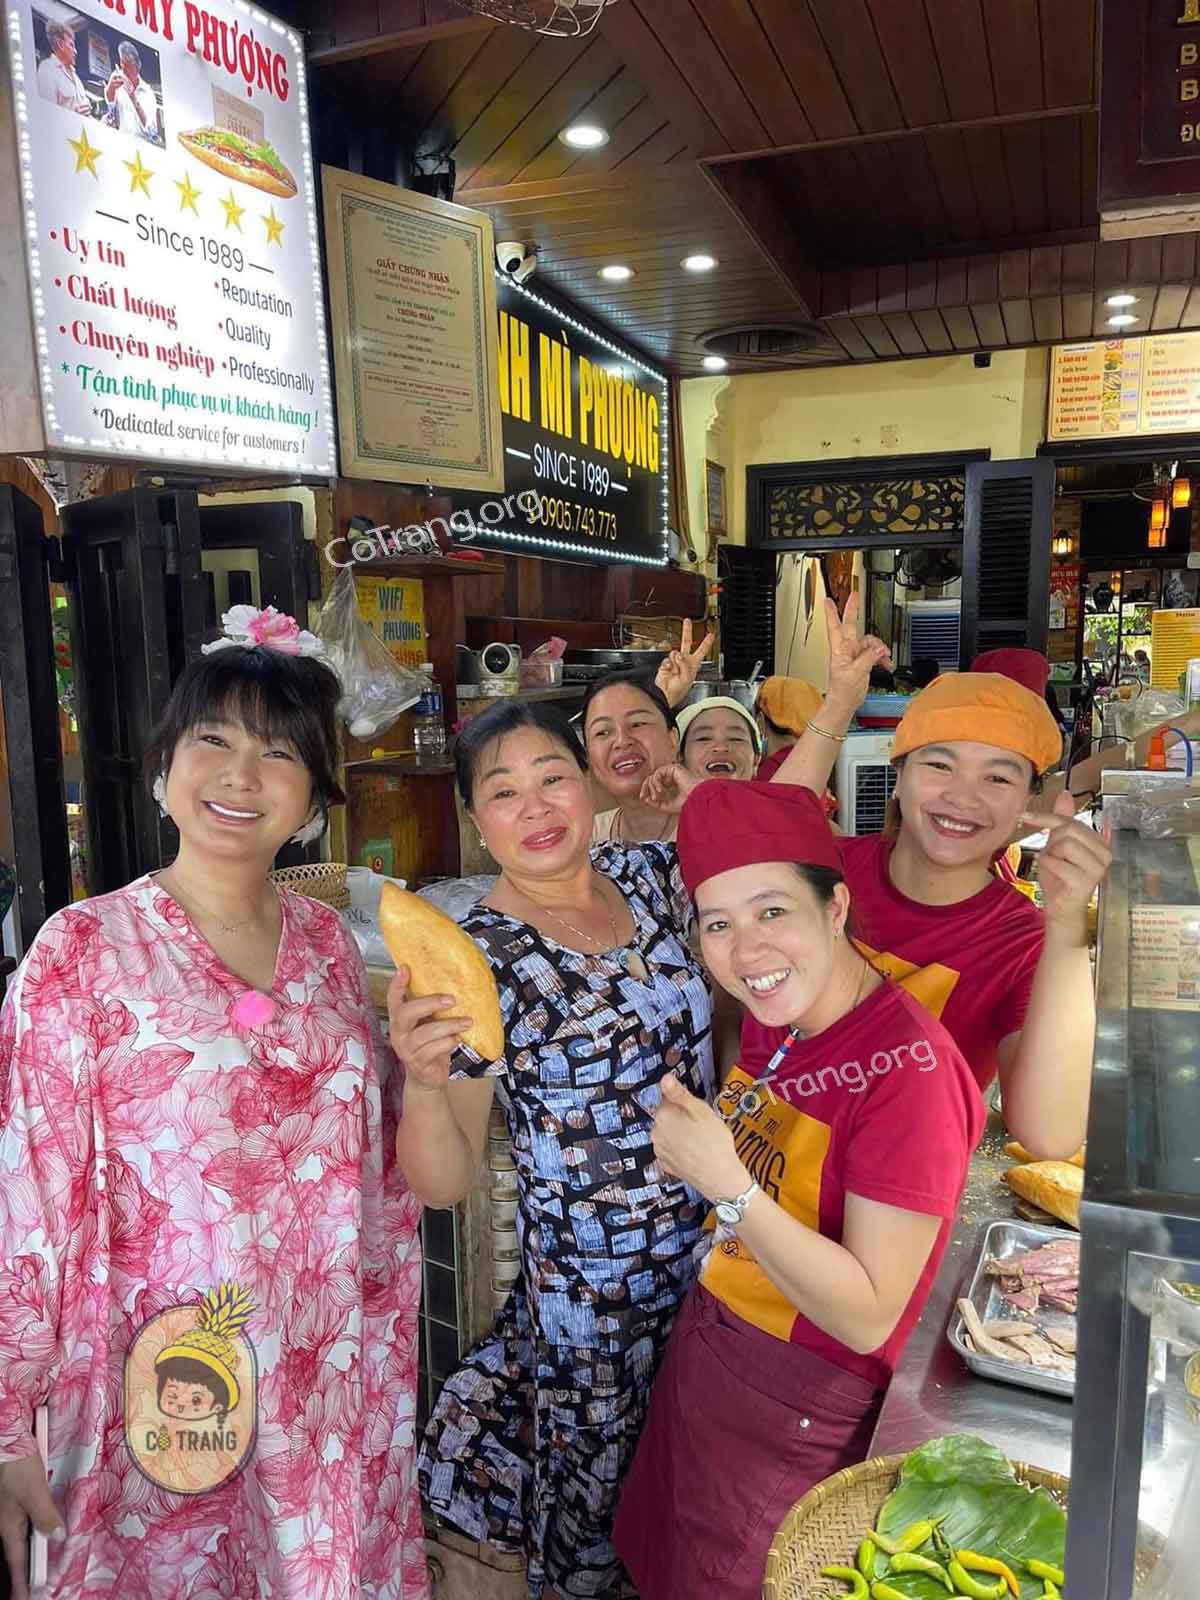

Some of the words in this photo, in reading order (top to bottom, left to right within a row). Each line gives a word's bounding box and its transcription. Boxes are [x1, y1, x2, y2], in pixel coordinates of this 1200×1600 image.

[184, 1, 289, 101] PHƯỢNG
[63, 226, 90, 264] Uy
[136, 214, 194, 256] Since
[200, 237, 244, 272] 1989
[67, 274, 119, 309] Chất
[124, 287, 178, 330] lượng
[221, 277, 293, 318] Reputation
[71, 320, 150, 361] Chuyên
[156, 342, 215, 378] nghiệp
[225, 317, 271, 351] Quality
[76, 363, 121, 397] Tận
[162, 383, 199, 411] phục
[236, 395, 276, 424] khách
[229, 356, 315, 395] Professionally
[539, 329, 573, 439] MÌ
[579, 355, 660, 478] PHƯỢNG
[177, 423, 221, 444] service
[222, 426, 240, 449] for
[533, 442, 577, 488] SINCE
[581, 459, 610, 496] 1989
[540, 495, 617, 541] 0905.743.773
